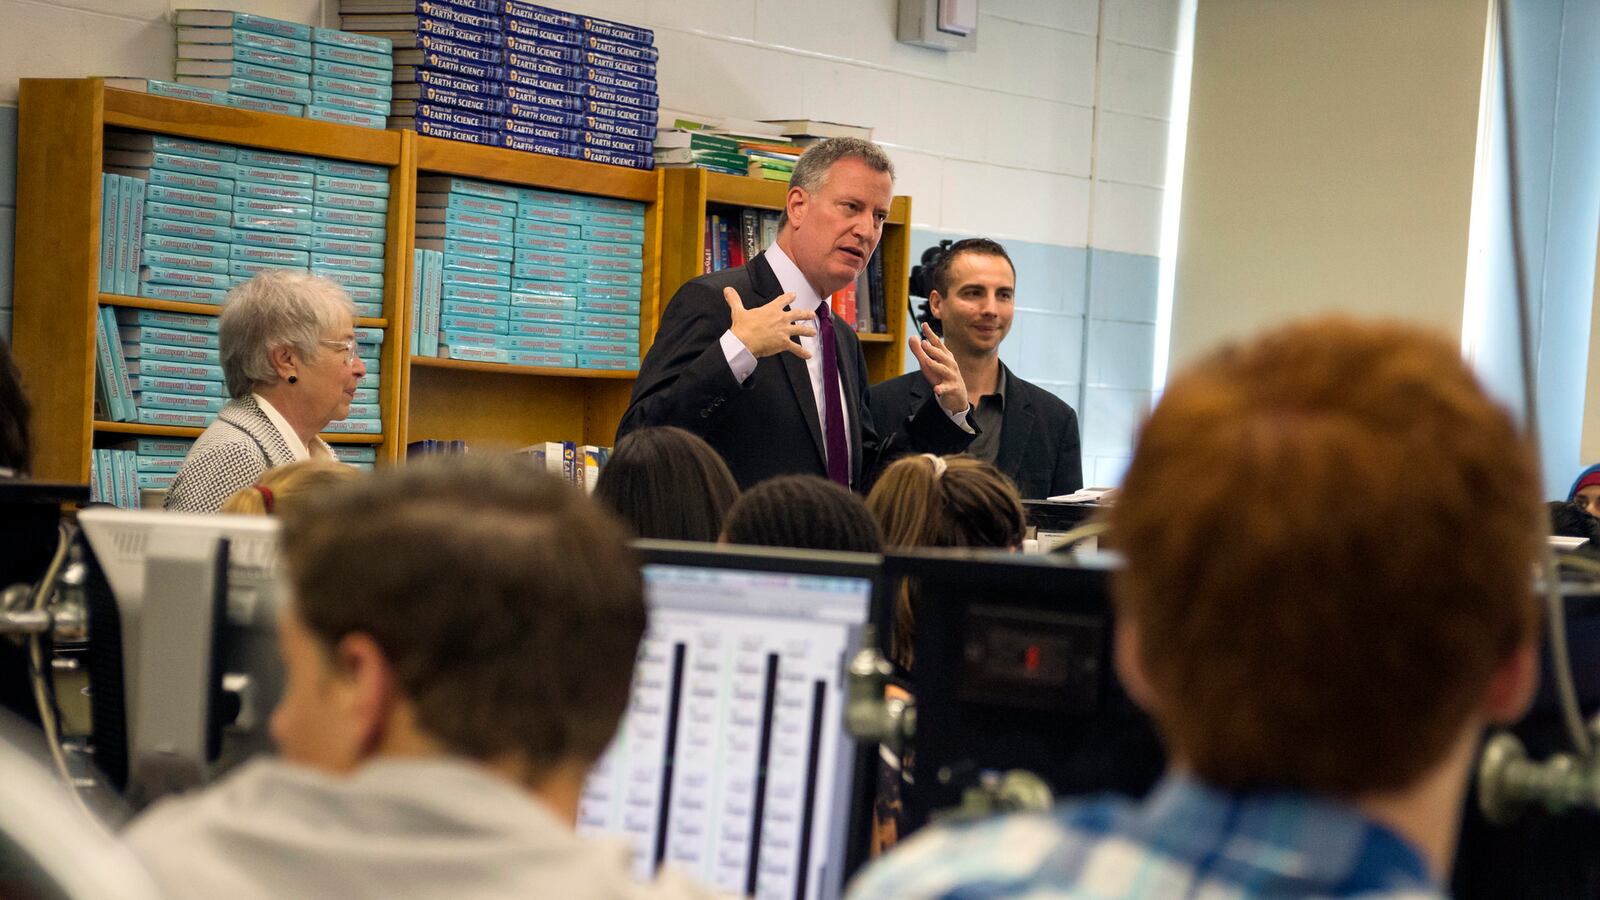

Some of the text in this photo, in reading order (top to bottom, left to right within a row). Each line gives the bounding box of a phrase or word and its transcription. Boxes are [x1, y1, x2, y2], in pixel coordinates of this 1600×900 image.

[431, 10, 452, 20] EARTH
[454, 14, 480, 25] SCIENCE
[512, 8, 532, 19] EARTH
[534, 12, 558, 24] SCIENCE
[433, 27, 454, 38] EARTH
[456, 31, 482, 42] SCIENCE
[518, 26, 538, 37] EARTH
[539, 30, 563, 41] SCIENCE
[592, 26, 635, 40] EARTH SCIENCE
[430, 43, 480, 58] EARTH SCIENCE
[515, 43, 535, 53] EARTH
[537, 46, 560, 58] SCIENCE
[597, 43, 615, 53] EARTH
[617, 47, 640, 57] SCIENCE
[437, 61, 458, 72] EARTH
[460, 66, 486, 76] SCIENCE
[516, 60, 536, 70] EARTH
[538, 63, 562, 75] SCIENCE
[594, 58, 613, 68] EARTH
[615, 62, 638, 73] SCIENCE
[430, 77, 451, 88] EARTH
[454, 81, 479, 92] SCIENCE
[518, 76, 538, 86] EARTH
[539, 79, 563, 91] SCIENCE
[595, 75, 613, 85] EARTH
[615, 79, 638, 89] SCIENCE
[435, 94, 456, 105] EARTH
[459, 99, 484, 109] SCIENCE
[516, 92, 536, 102] EARTH
[538, 95, 562, 107] SCIENCE
[596, 91, 614, 101] EARTH
[617, 95, 639, 105] SCIENCE
[430, 111, 451, 122] EARTH
[454, 115, 479, 126] SCIENCE
[518, 109, 538, 119] EARTH
[540, 112, 563, 124] SCIENCE
[597, 107, 615, 117] EARTH
[617, 111, 640, 121] SCIENCE
[430, 127, 479, 142] EARTH SCIENCE
[513, 124, 533, 134] EARTH
[535, 127, 559, 139] SCIENCE
[595, 122, 613, 132] EARTH
[616, 126, 638, 137] SCIENCE
[513, 140, 558, 155] EARTH SCIENCE
[592, 137, 610, 147] EARTH
[612, 141, 635, 152] SCIENCE
[592, 153, 635, 167] EARTH SCIENCE
